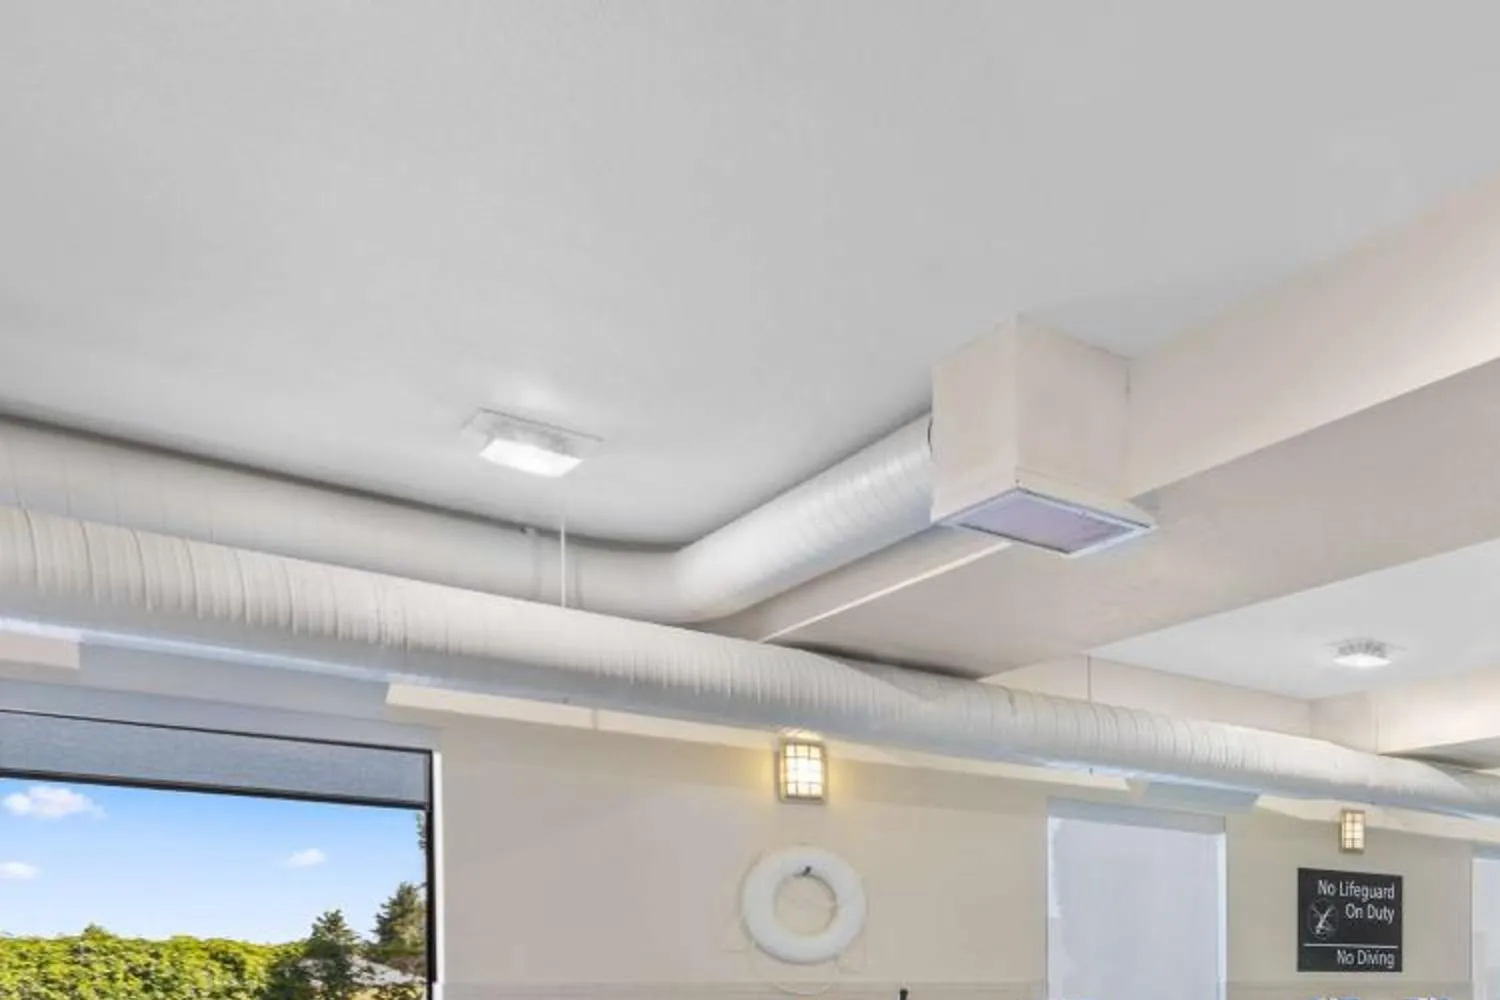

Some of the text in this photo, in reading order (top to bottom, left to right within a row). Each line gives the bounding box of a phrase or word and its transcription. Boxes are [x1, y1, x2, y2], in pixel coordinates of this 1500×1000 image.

[1317, 879, 1395, 902] No Lifeguard
[1345, 903, 1395, 924] On Duty
[1336, 949, 1395, 969] No Diving
